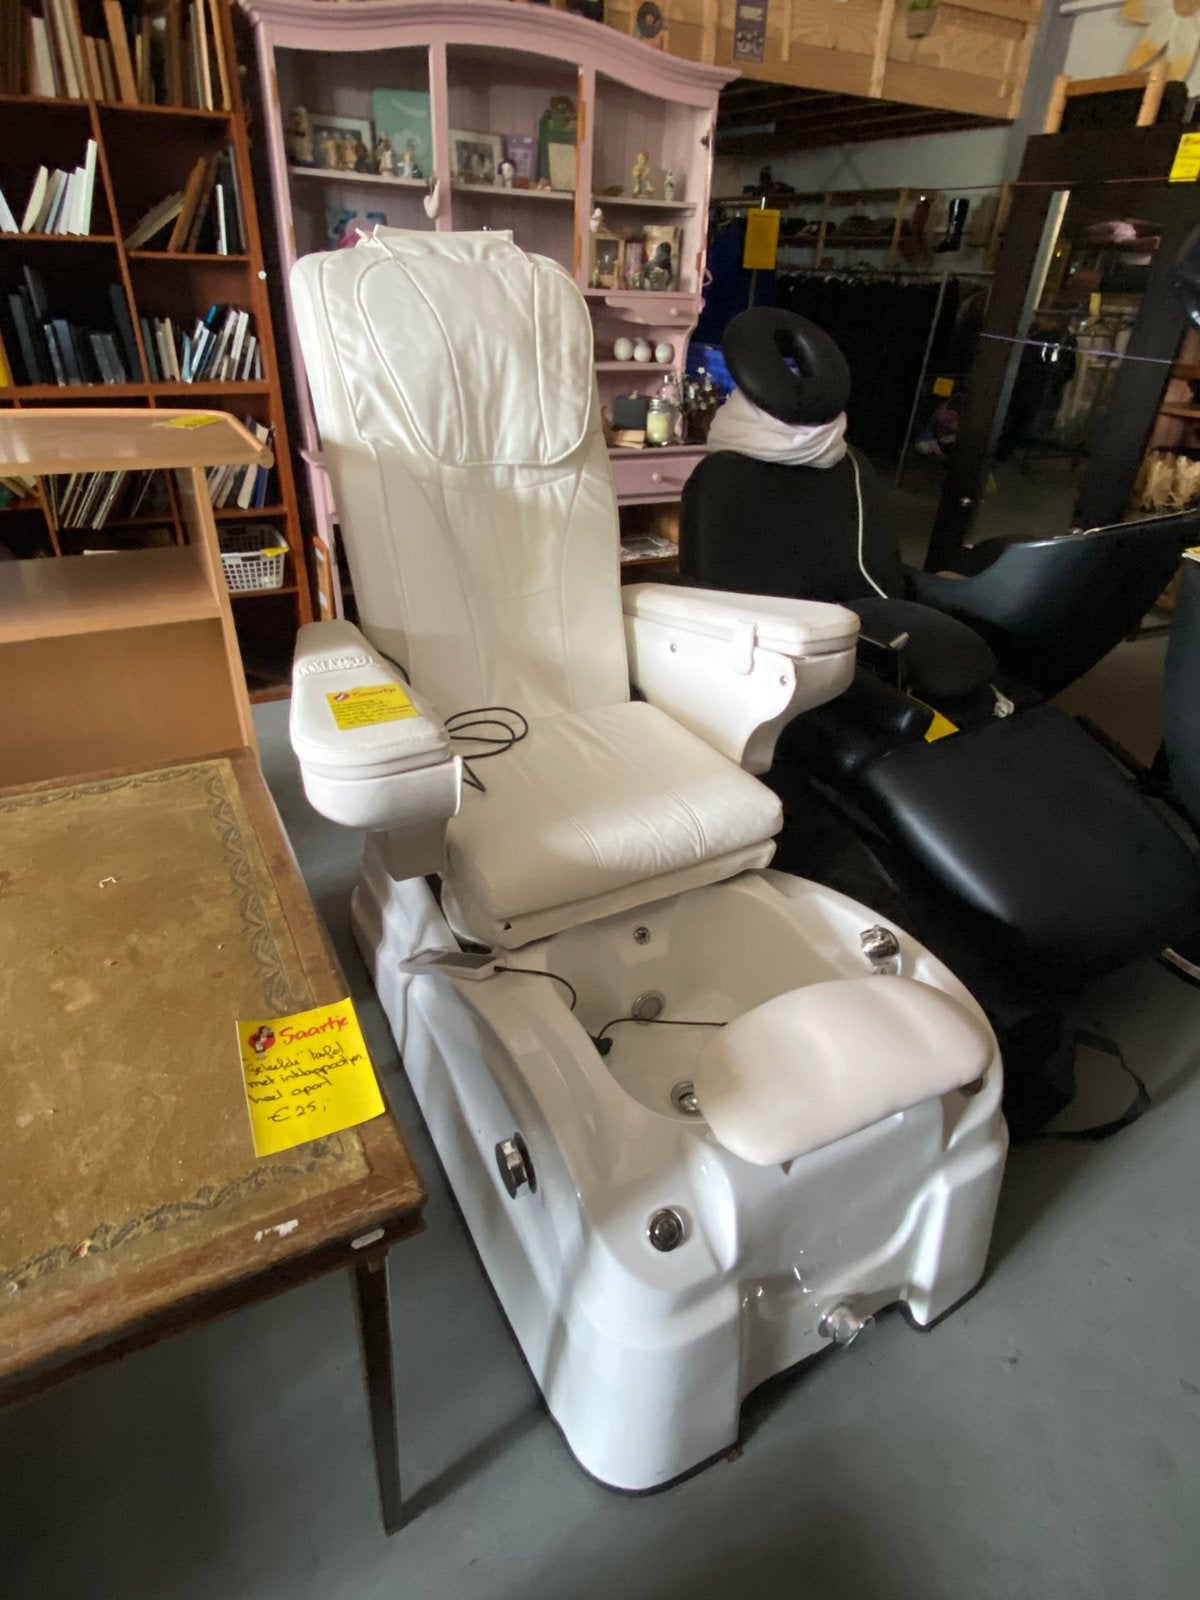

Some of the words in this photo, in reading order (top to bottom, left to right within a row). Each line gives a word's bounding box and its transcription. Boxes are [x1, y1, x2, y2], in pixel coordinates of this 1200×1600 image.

[279, 1016, 349, 1045] Saartje
[309, 1040, 344, 1060] tafel
[248, 1075, 275, 1088] met
[291, 1075, 333, 1096] apart
